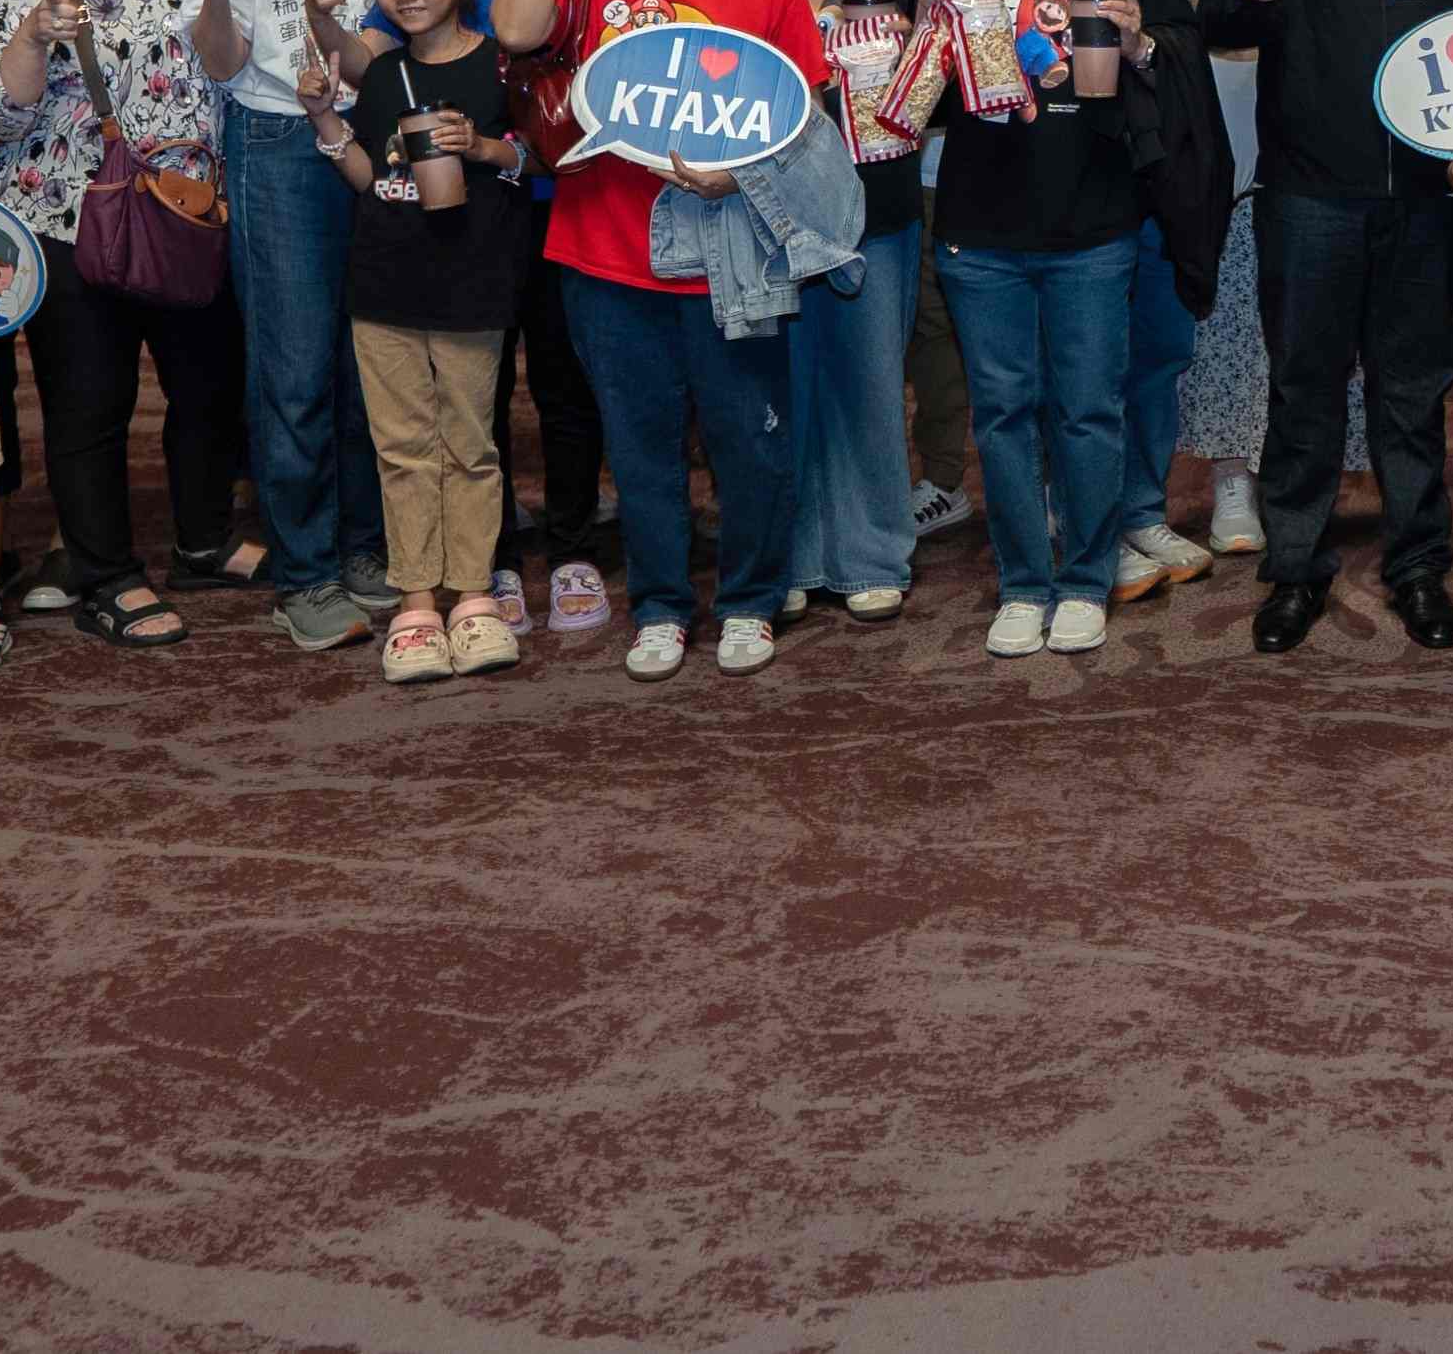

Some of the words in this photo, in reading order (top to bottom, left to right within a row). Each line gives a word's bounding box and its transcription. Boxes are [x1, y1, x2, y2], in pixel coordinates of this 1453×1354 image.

[666, 37, 685, 79] I
[1418, 37, 1451, 96] i
[608, 80, 772, 143] KTAXA
